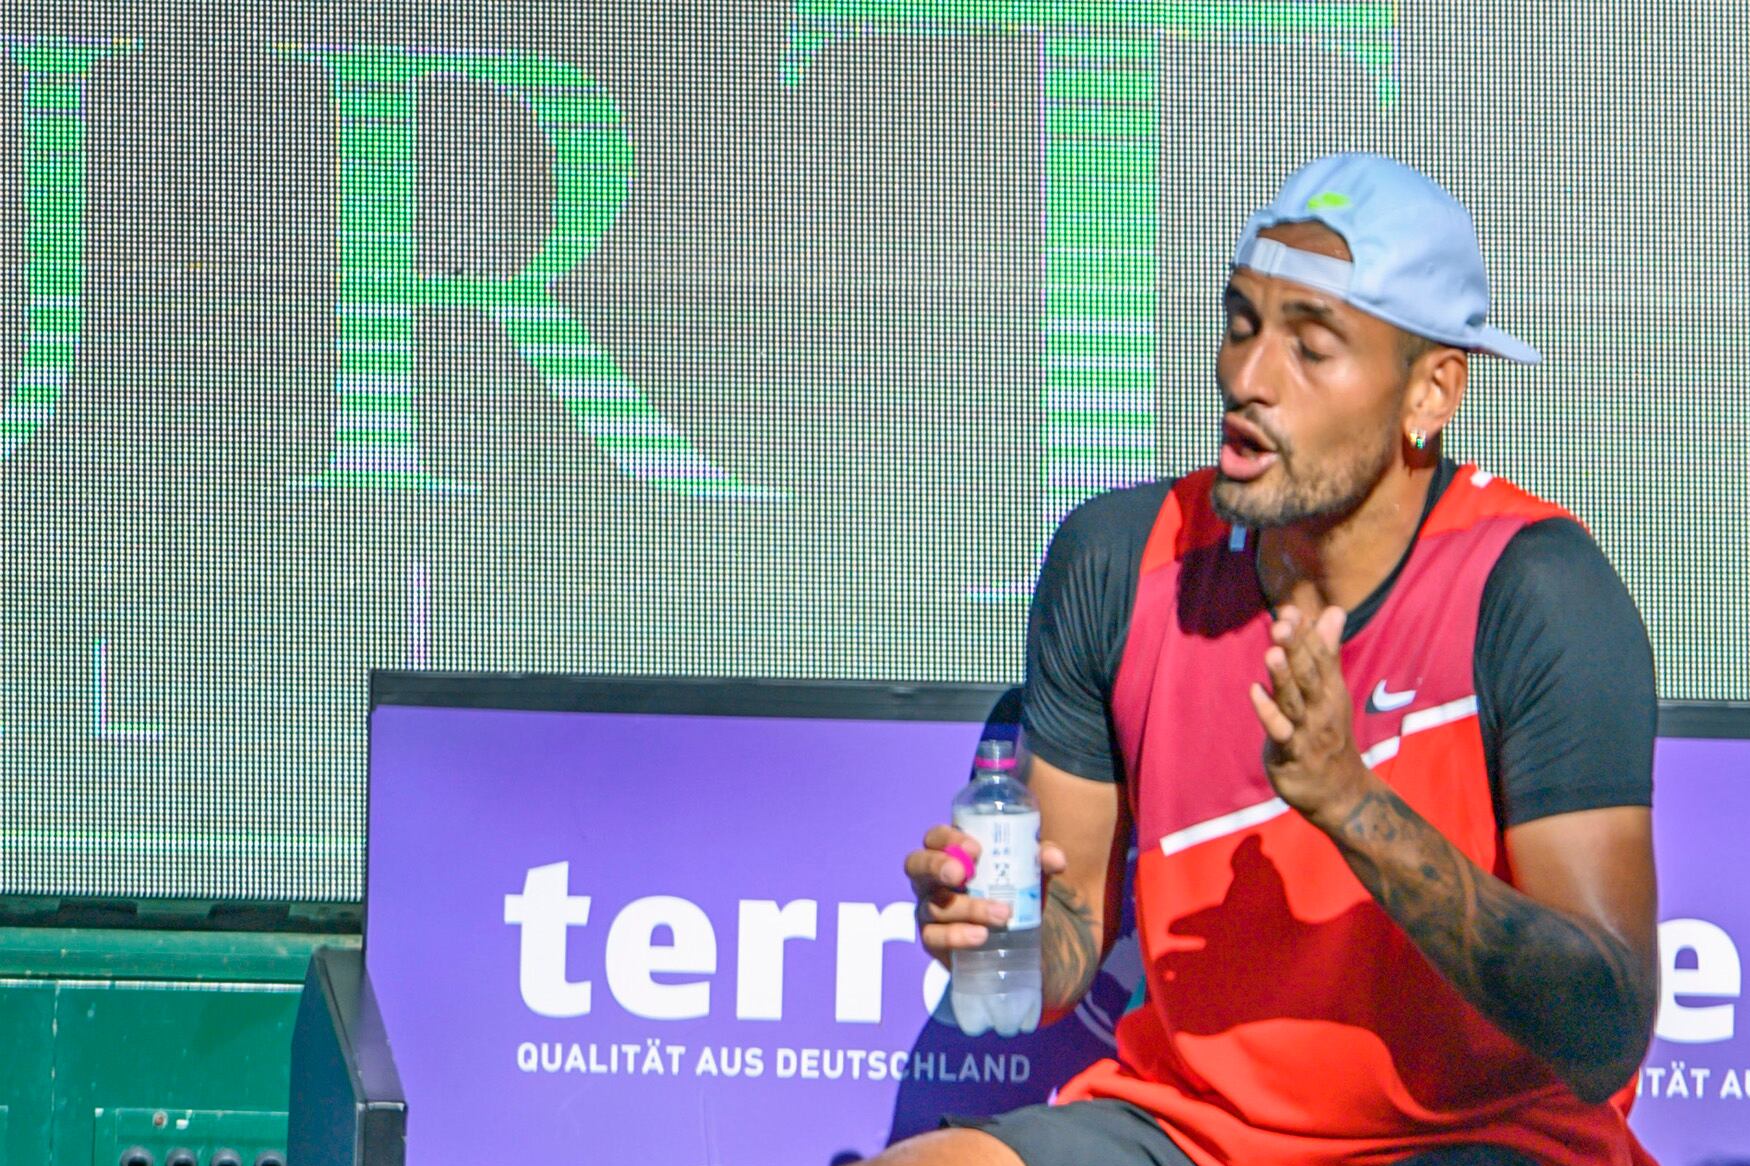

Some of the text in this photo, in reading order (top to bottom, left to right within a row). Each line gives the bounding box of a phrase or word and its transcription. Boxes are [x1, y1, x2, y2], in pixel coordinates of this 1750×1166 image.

[504, 861, 955, 1024] terr
[516, 1038, 1031, 1084] QUALITÄT AUS DEUTSCHLAND
[1636, 1060, 1711, 1100] ITÄT
